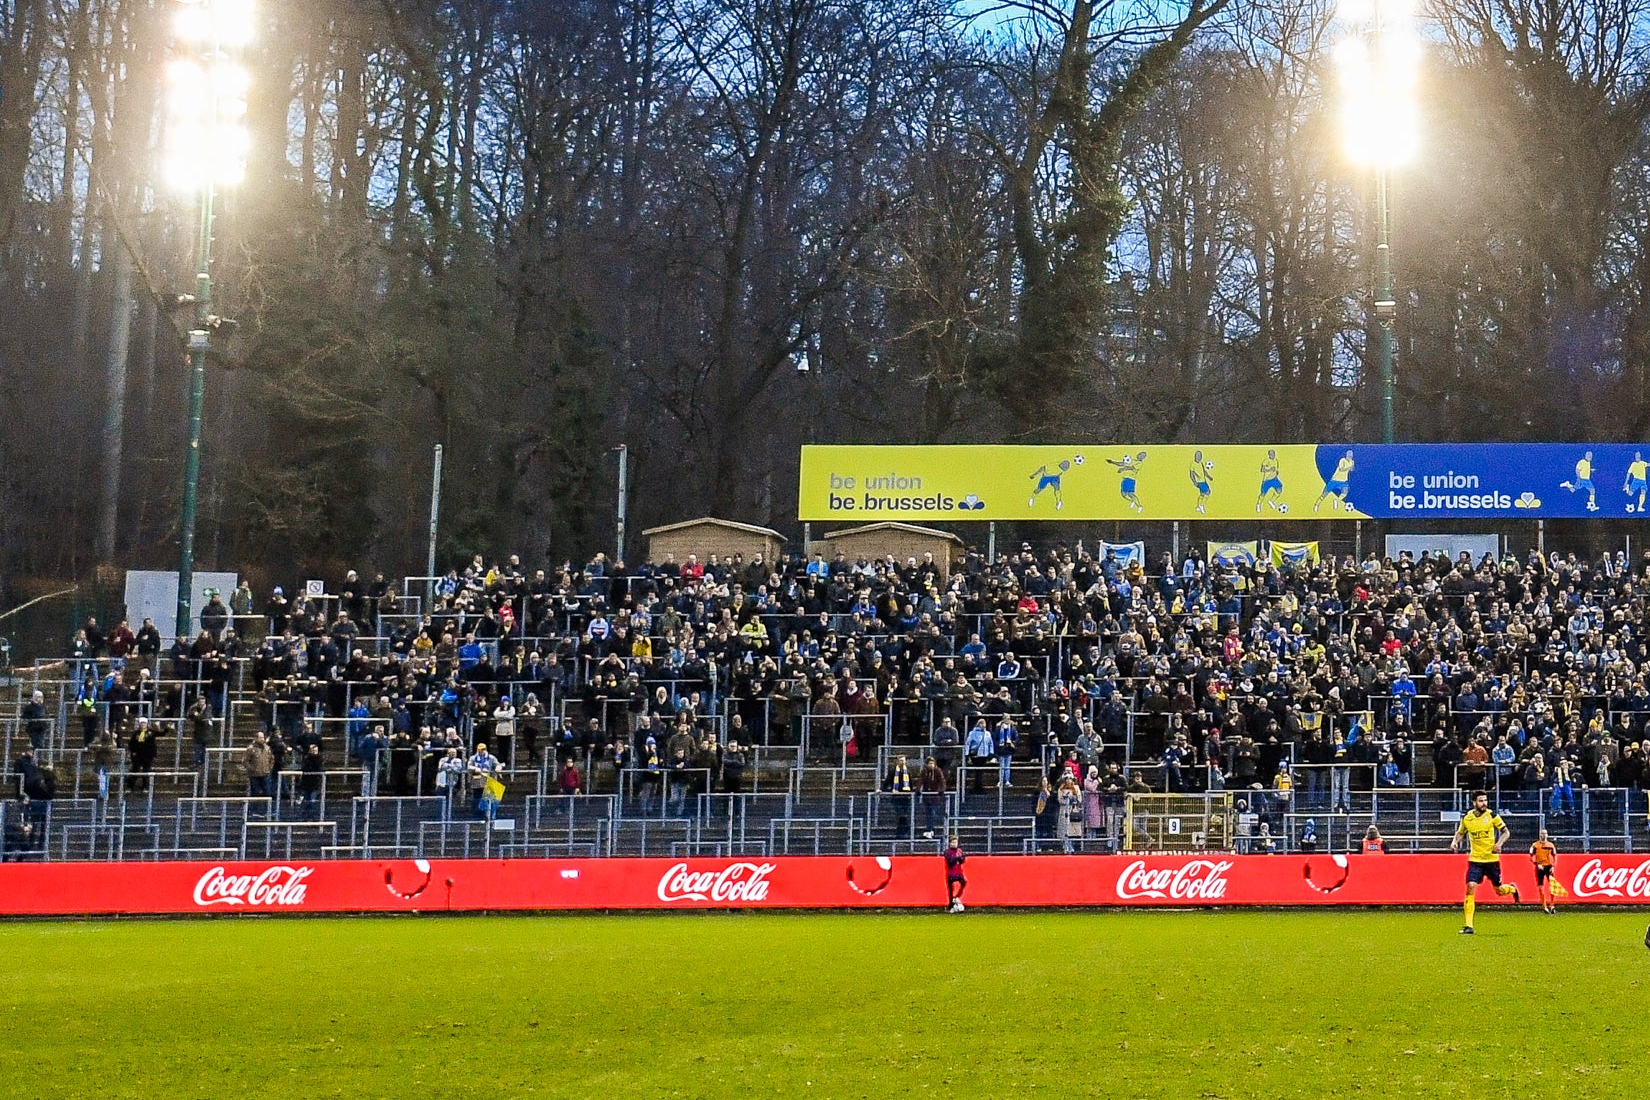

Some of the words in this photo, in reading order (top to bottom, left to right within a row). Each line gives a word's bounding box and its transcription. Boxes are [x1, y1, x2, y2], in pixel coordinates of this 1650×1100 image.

[830, 473, 855, 490] be
[865, 473, 922, 490] union
[1389, 471, 1415, 489] be
[1423, 471, 1479, 489] union
[193, 866, 314, 906] Coca-Cola
[657, 862, 777, 902] Coca-Cola
[1116, 860, 1234, 899] Coca-Cola
